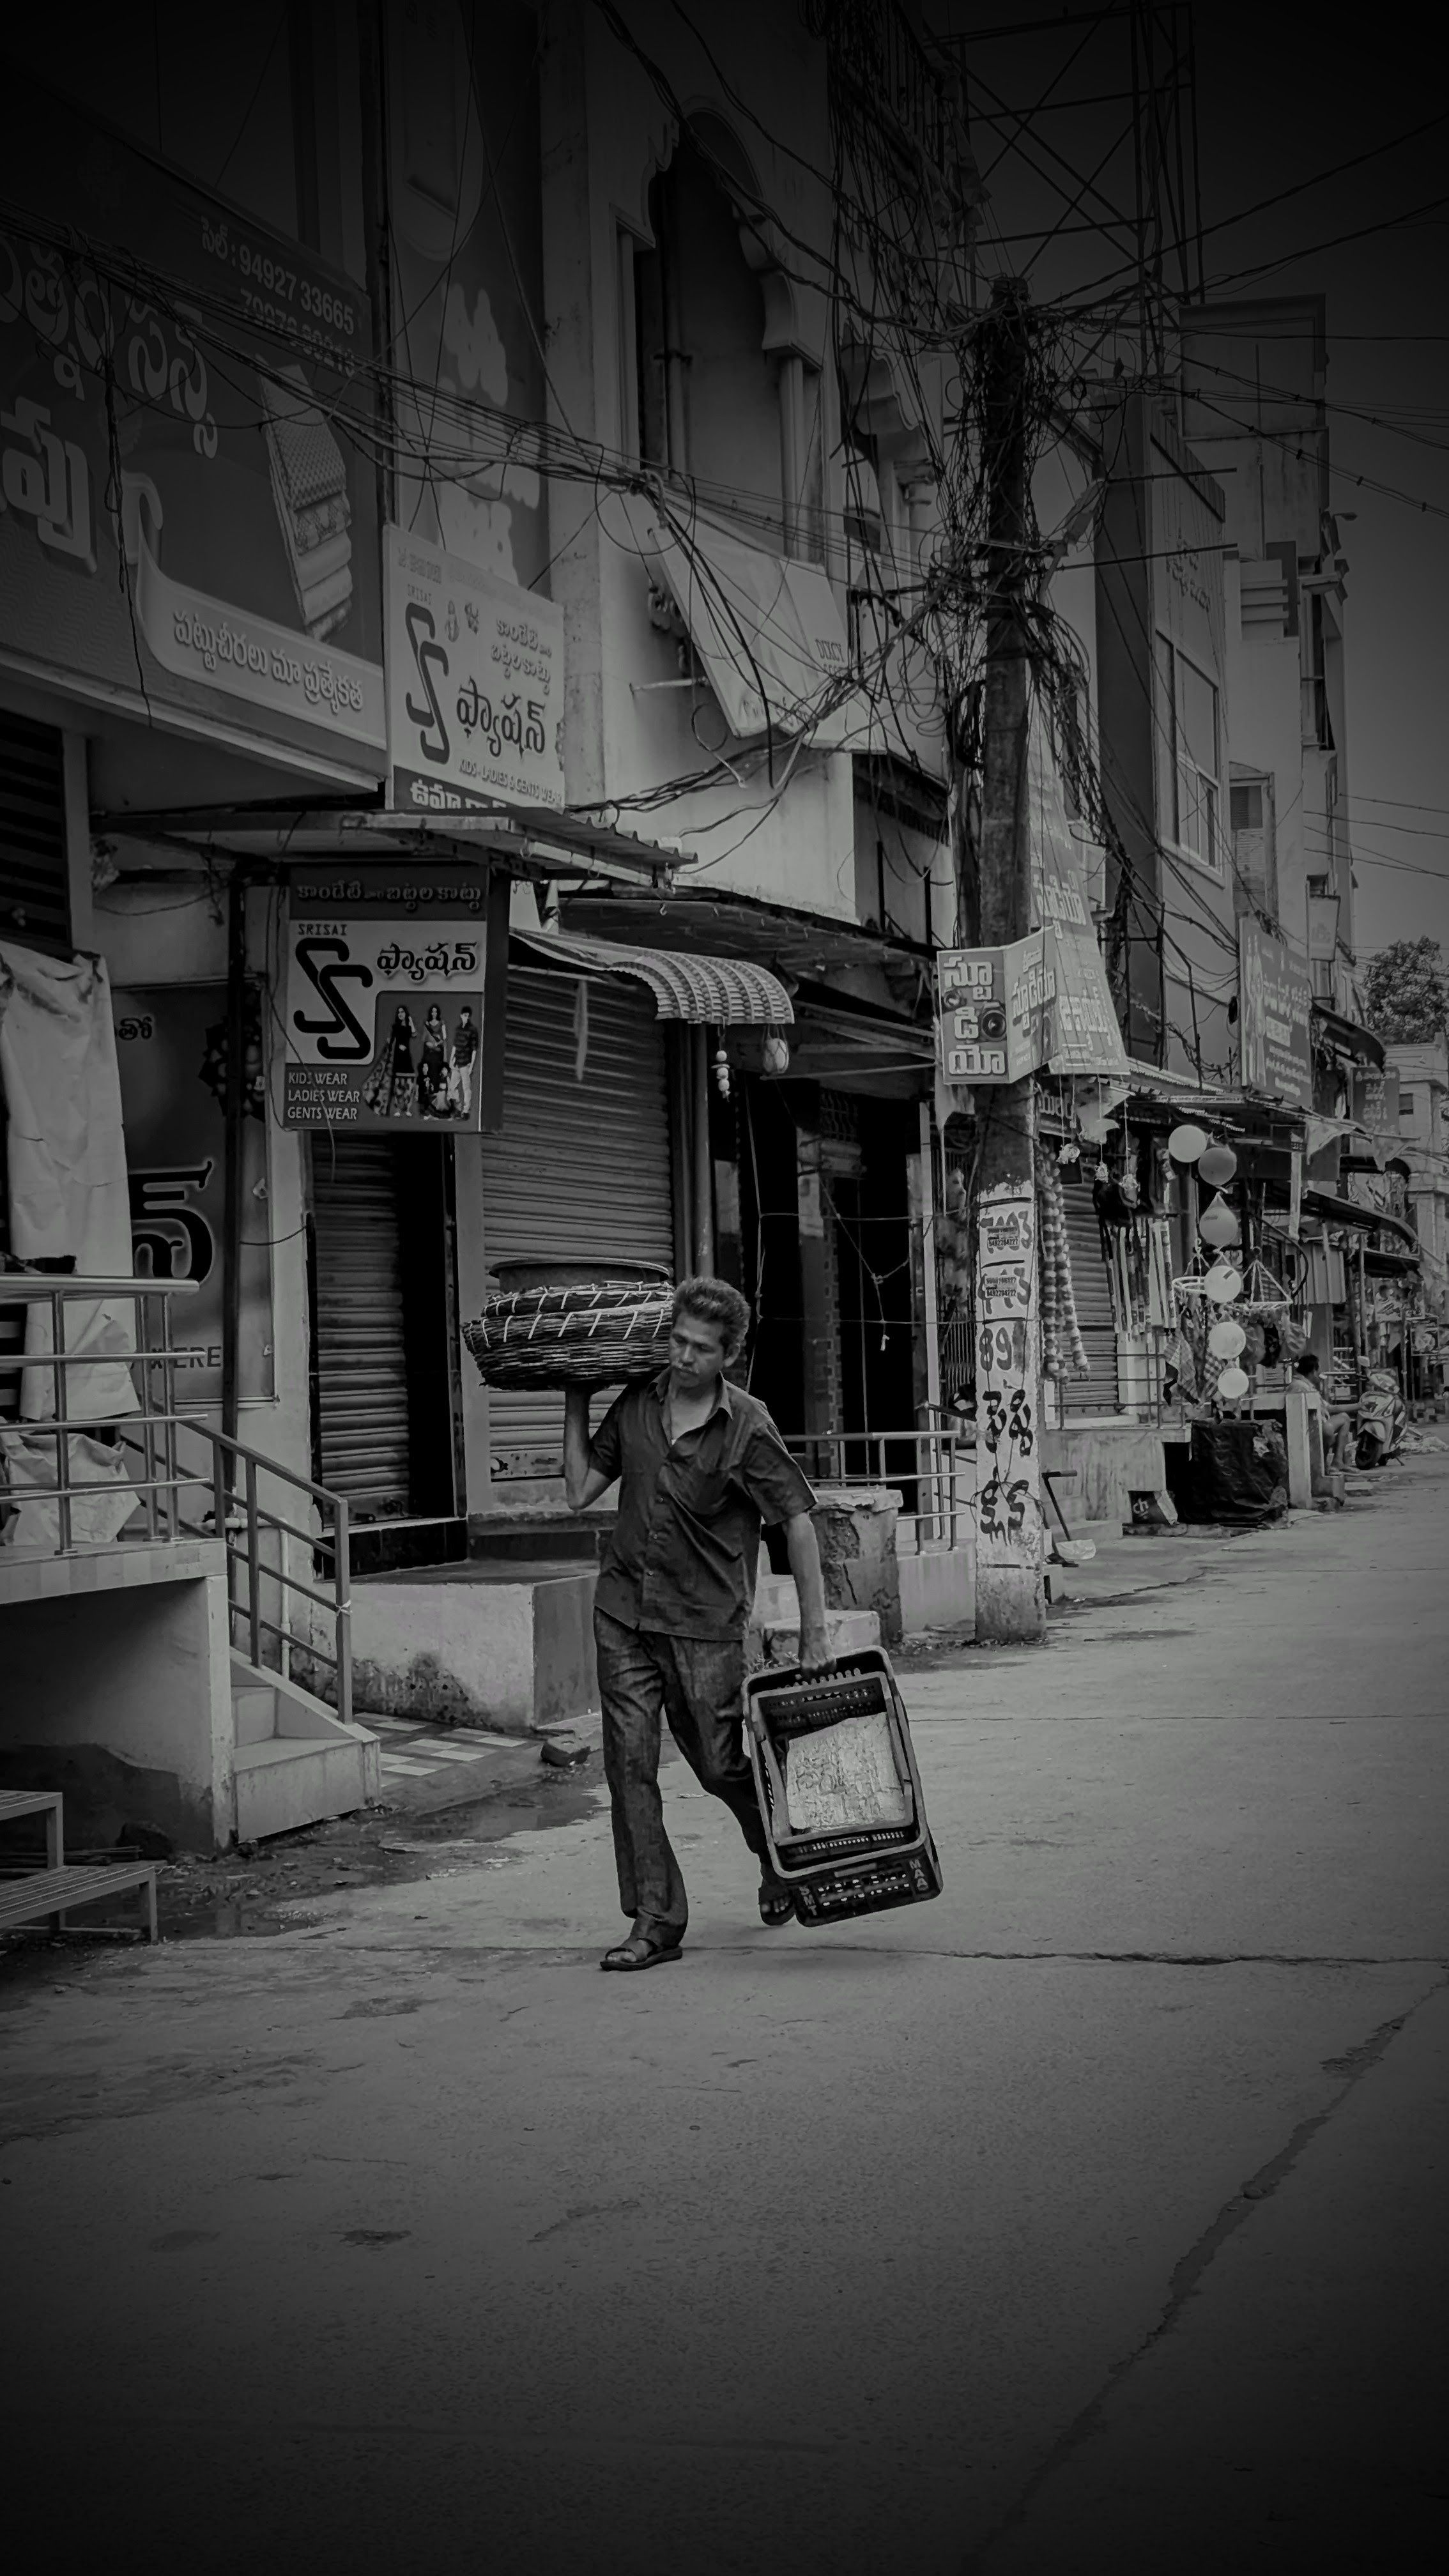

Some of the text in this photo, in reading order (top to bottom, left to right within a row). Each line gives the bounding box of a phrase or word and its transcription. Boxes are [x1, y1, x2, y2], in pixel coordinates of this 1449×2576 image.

[240, 244, 297, 302] 94927
[300, 281, 354, 335] 33665
[272, 648, 302, 684] మా
[298, 923, 348, 937] SRISAI
[376, 942, 477, 981] ఫ్యాషన్
[314, 1072, 348, 1085] WEAR
[288, 1088, 361, 1104] LADIES WEAR
[287, 1105, 358, 1121] GENTS WEAR
